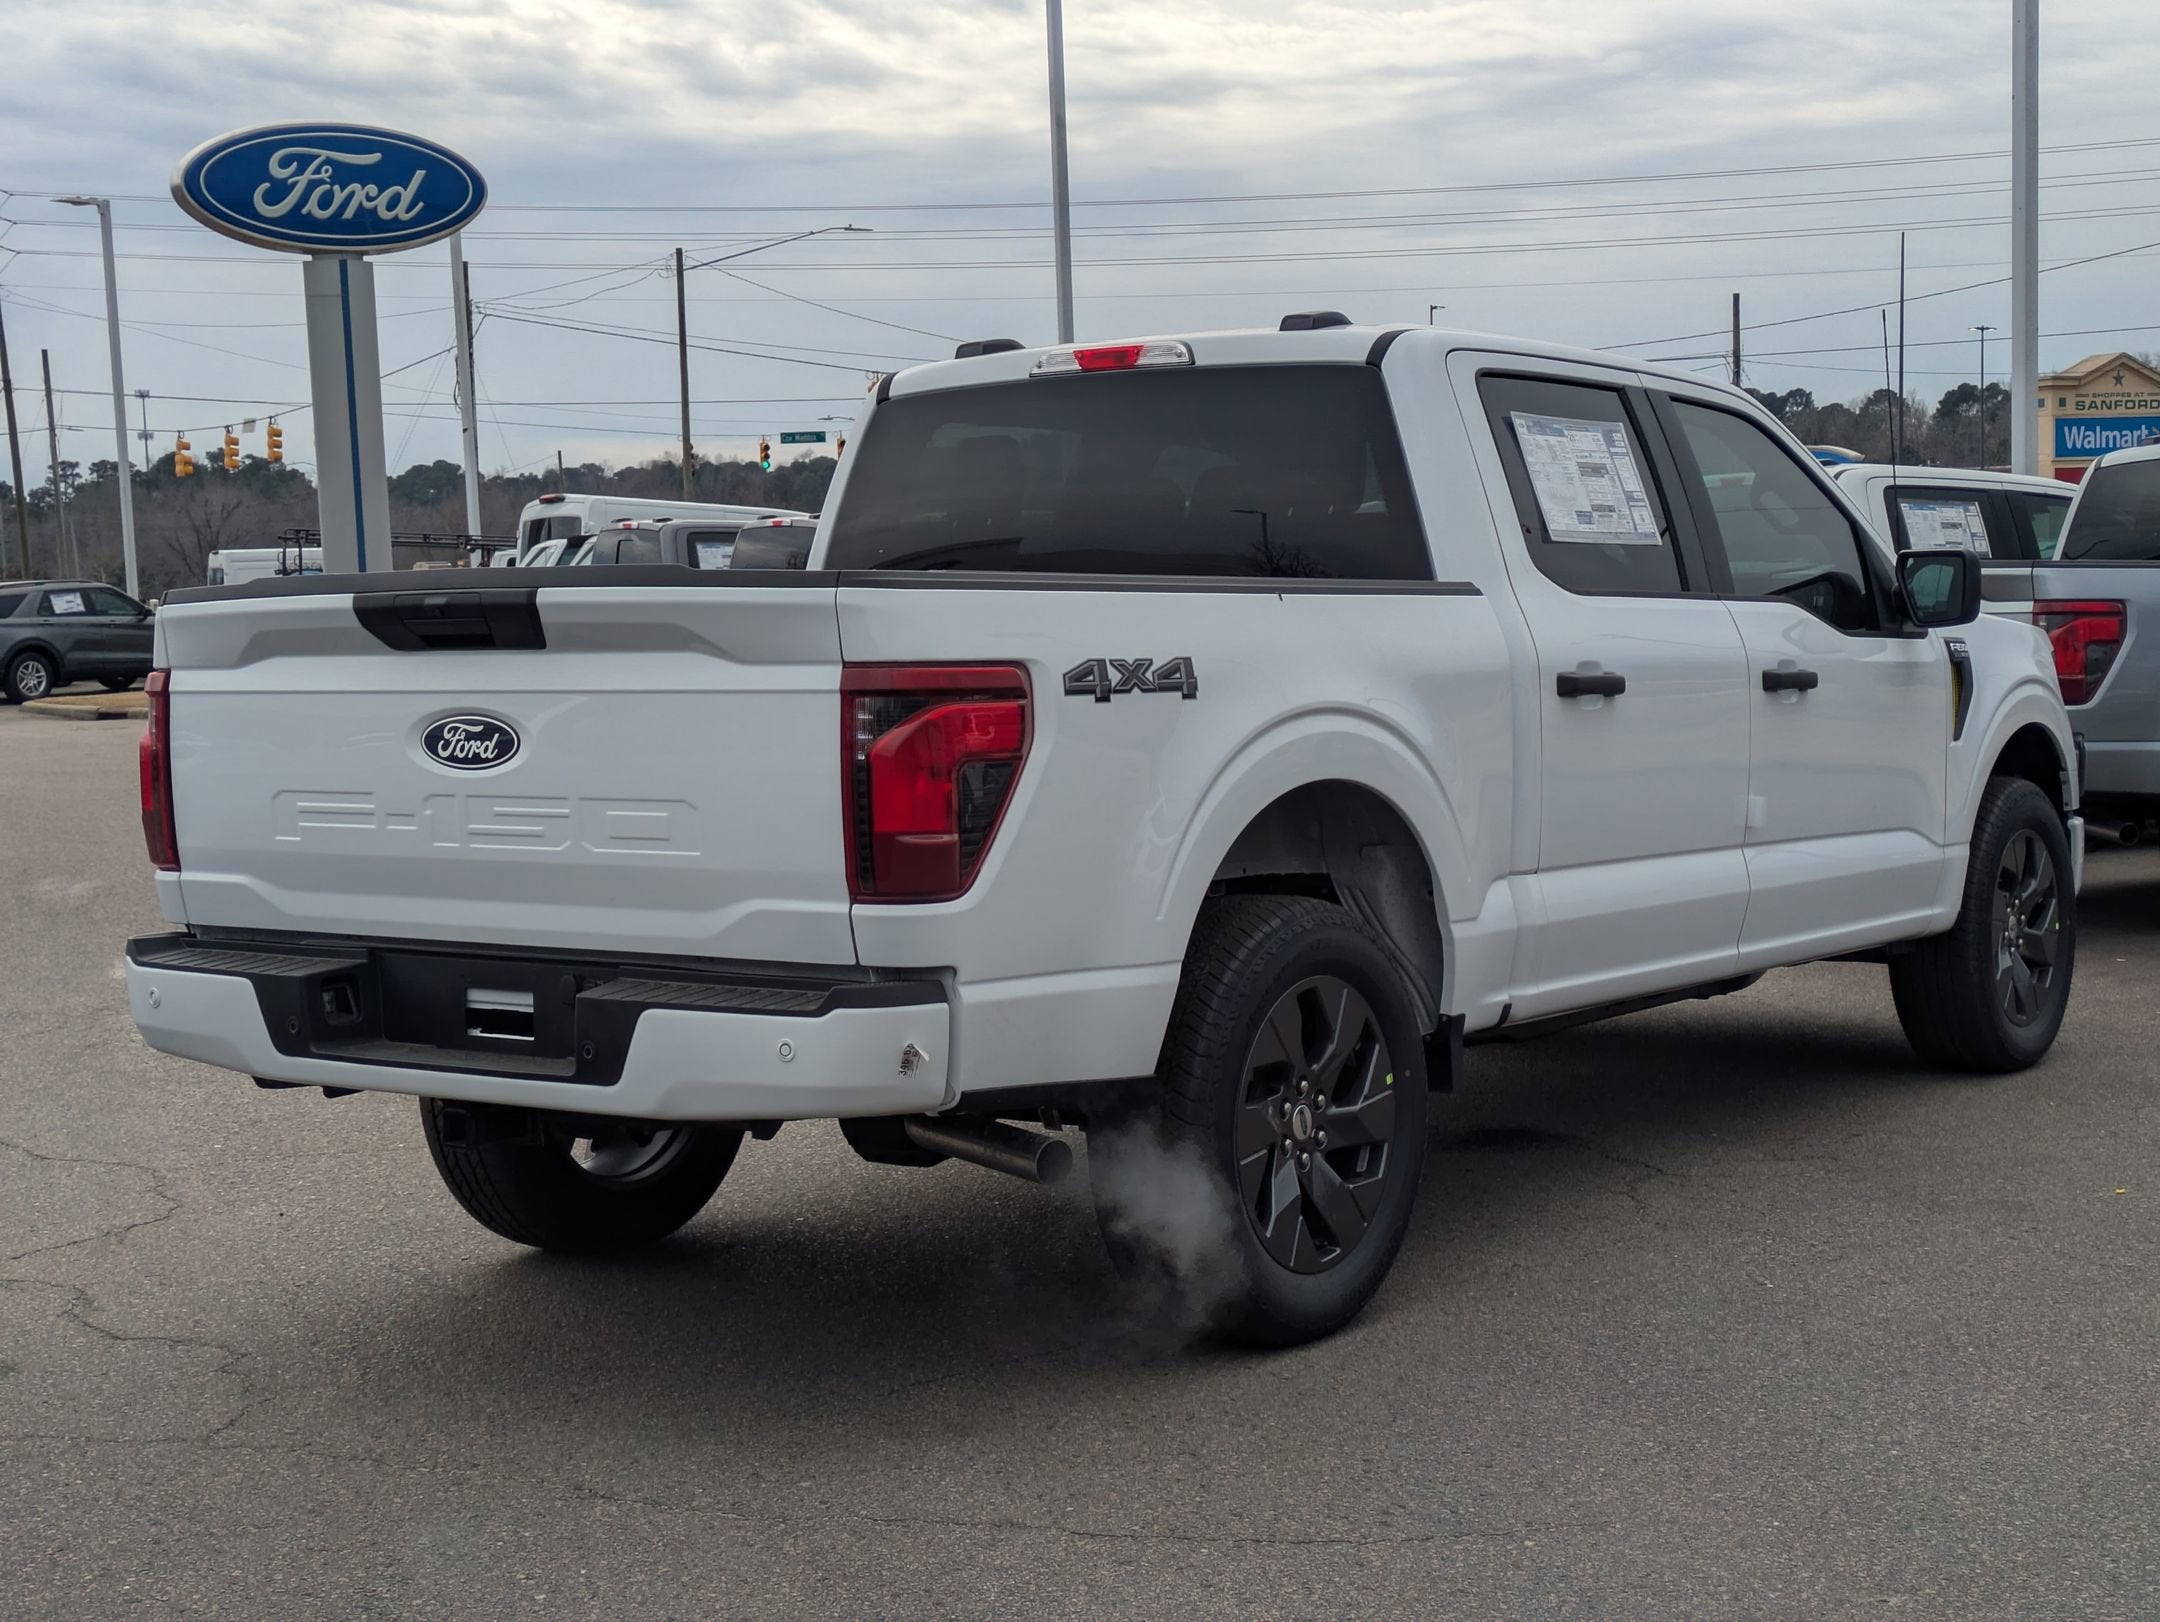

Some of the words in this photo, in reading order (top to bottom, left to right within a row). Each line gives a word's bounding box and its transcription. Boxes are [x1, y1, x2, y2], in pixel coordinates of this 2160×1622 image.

[253, 147, 427, 221] Ford
[2075, 399, 2160, 411] SANFORD
[437, 723, 500, 759] Ford
[272, 789, 701, 855] F-150
